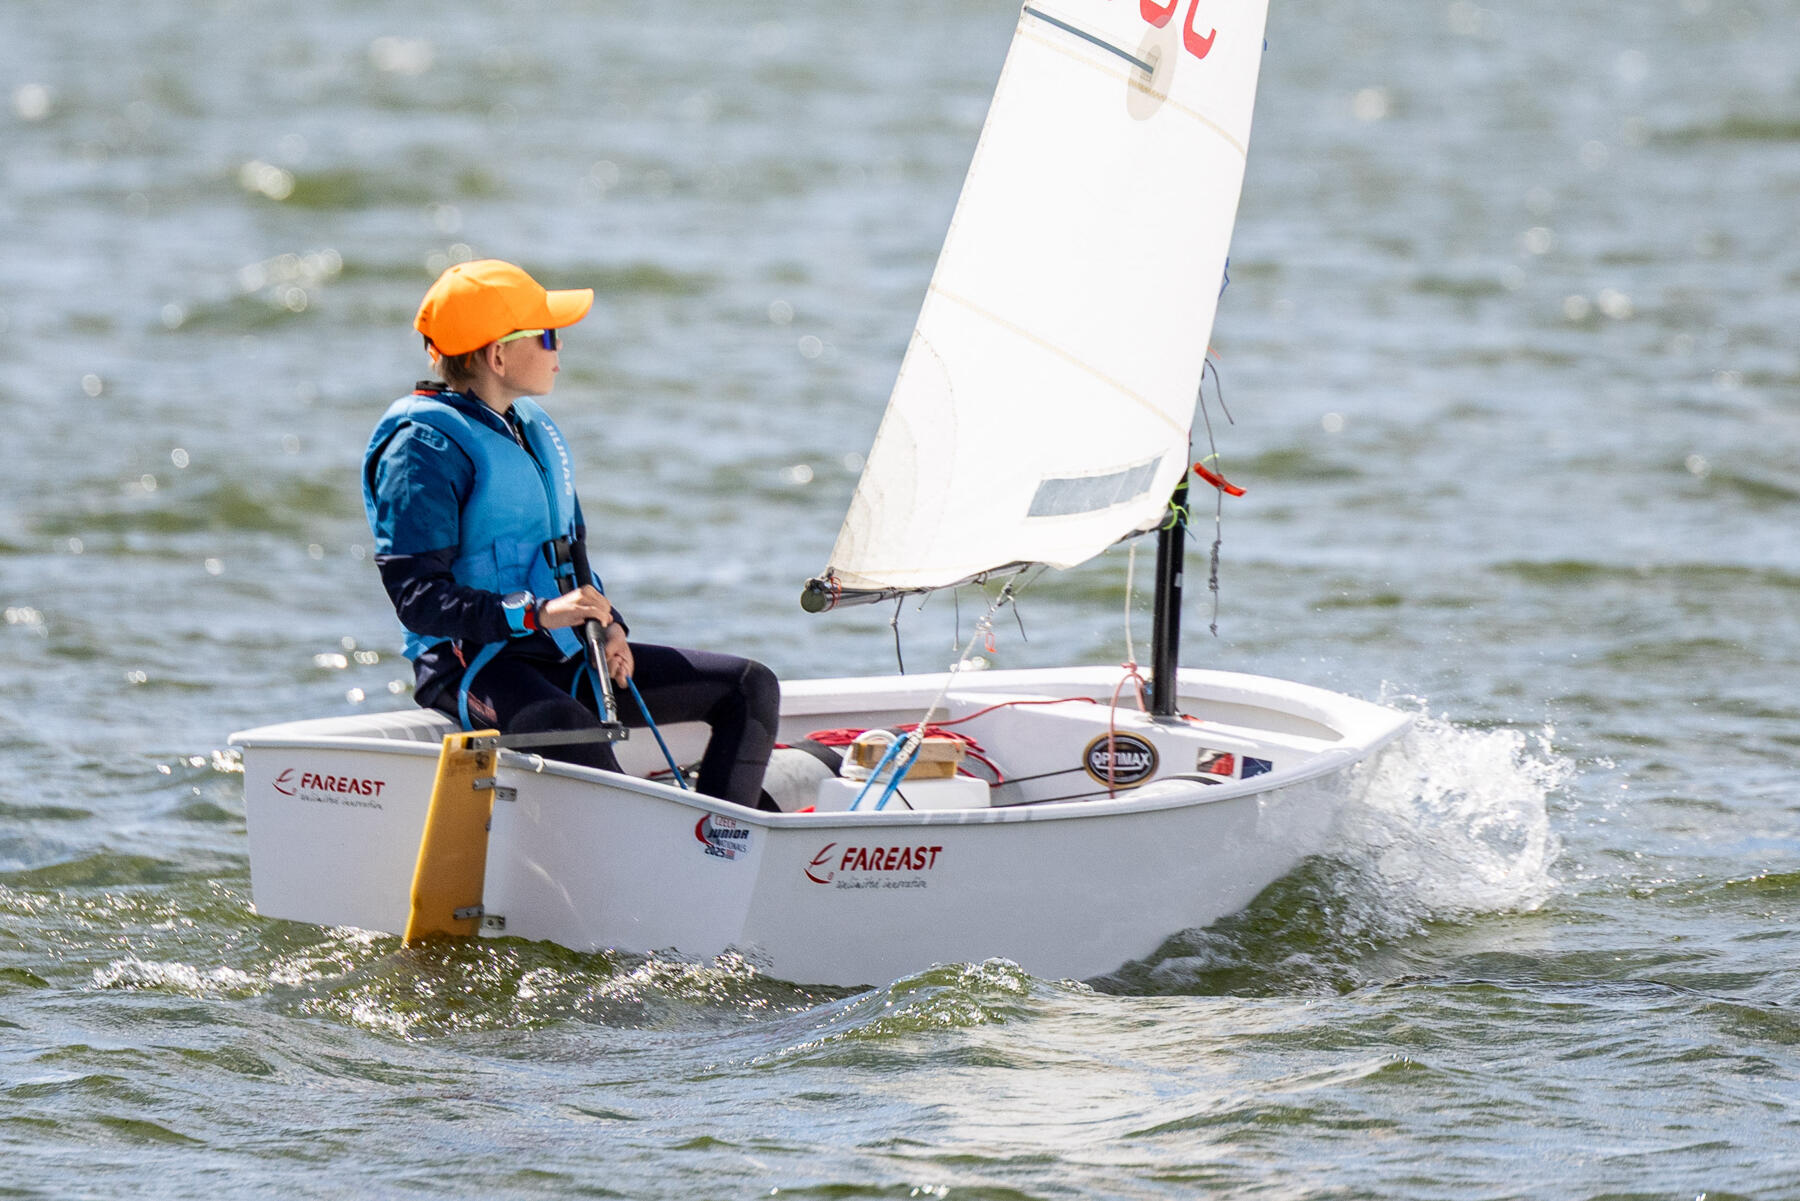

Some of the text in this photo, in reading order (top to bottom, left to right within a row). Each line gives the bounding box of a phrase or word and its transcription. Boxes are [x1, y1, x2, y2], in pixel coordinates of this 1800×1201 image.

[301, 773, 385, 796] FAREAST
[715, 815, 737, 829] CZECH
[708, 828, 750, 839] JUNIOR
[704, 845, 726, 858] 2025
[839, 846, 943, 871] FAREAST
